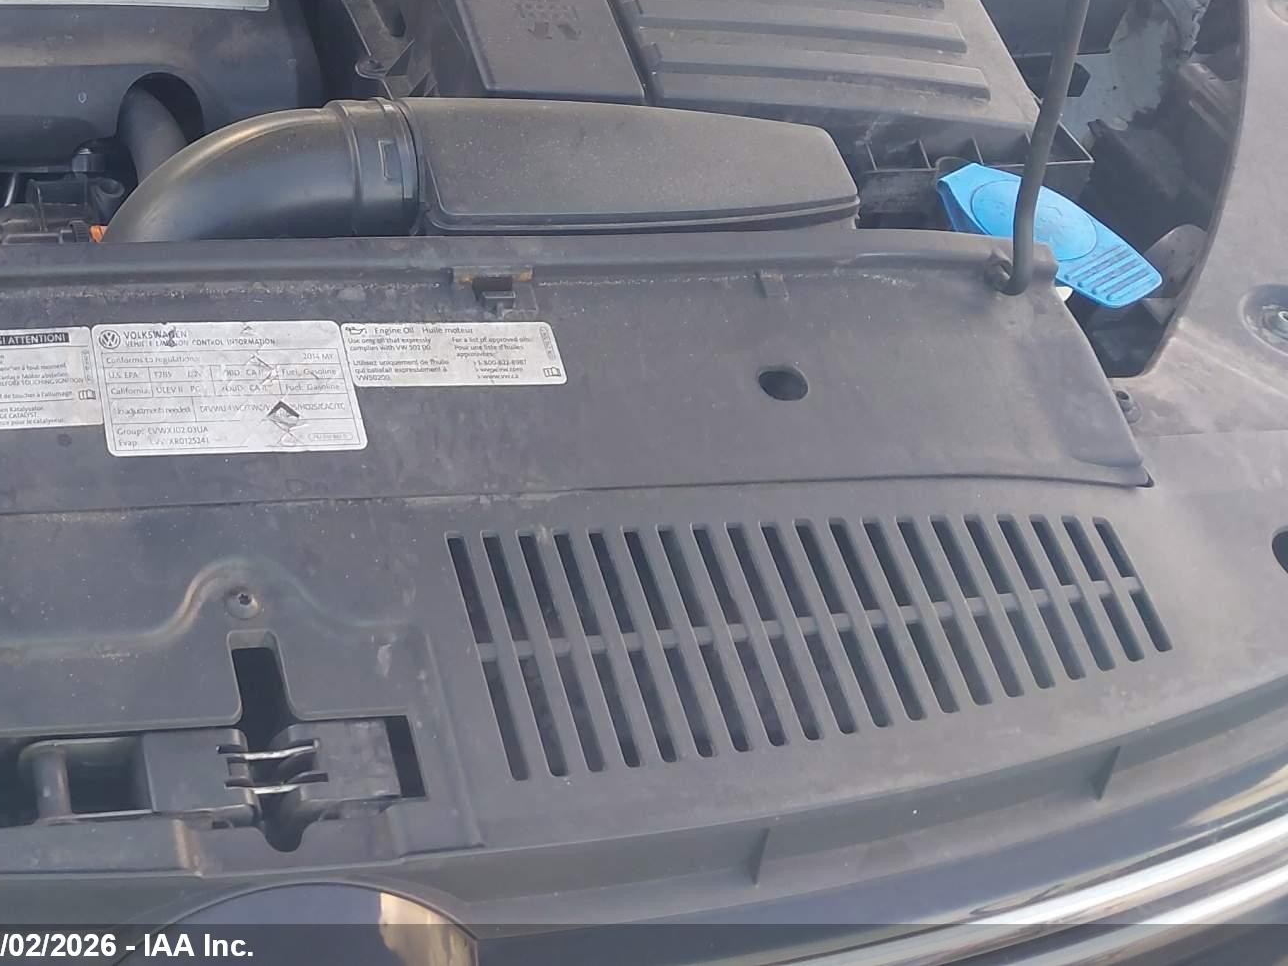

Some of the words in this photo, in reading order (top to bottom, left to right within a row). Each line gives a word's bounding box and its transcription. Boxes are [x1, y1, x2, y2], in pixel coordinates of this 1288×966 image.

[374, 326, 402, 336] Engine
[402, 326, 414, 334] Oil
[422, 326, 443, 334] Huile
[8, 333, 66, 345] ATTENTION!
[226, 338, 276, 346] INFORMATION
[488, 336, 518, 344] approved
[106, 356, 143, 364] Conforms
[303, 352, 320, 360] 2014
[321, 352, 334, 360] MY
[378, 359, 419, 367] uniquement
[303, 368, 337, 376] Gasoline
[354, 367, 367, 375] qui
[306, 383, 340, 391] Gasoline
[116, 427, 144, 436] Group:
